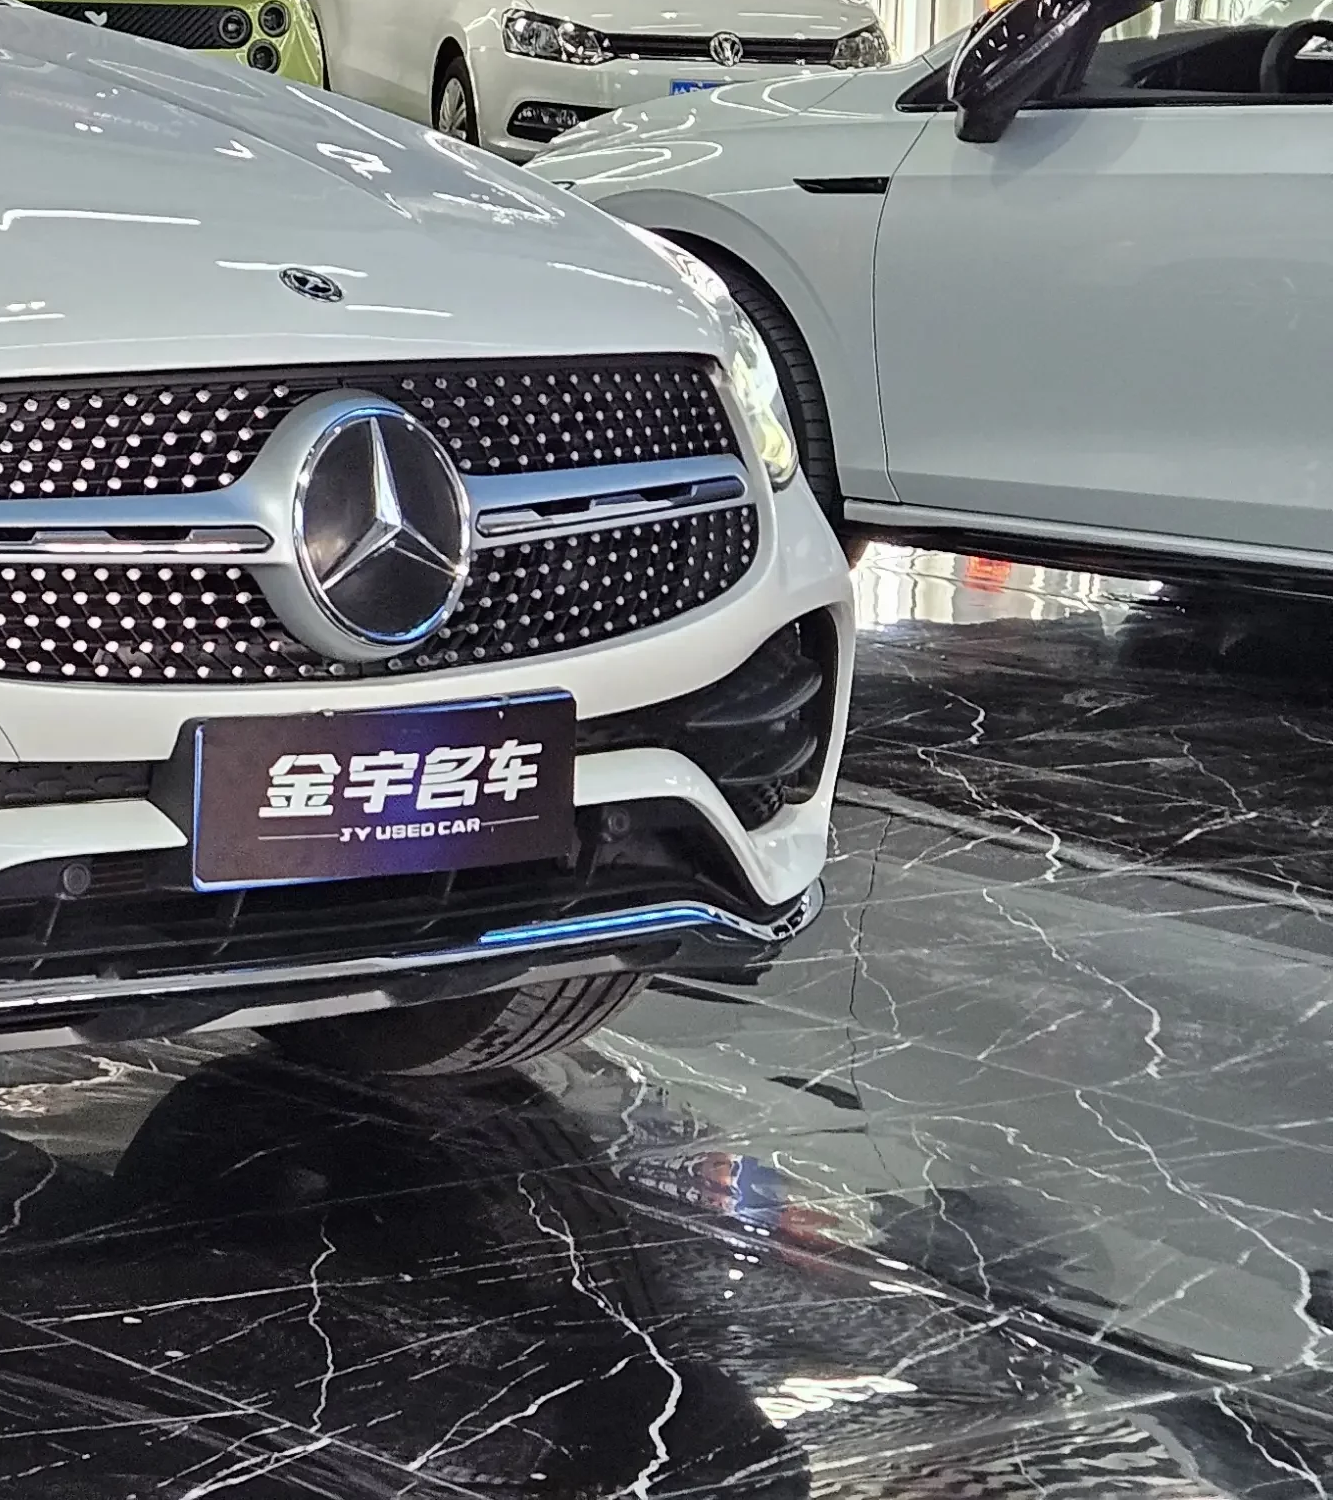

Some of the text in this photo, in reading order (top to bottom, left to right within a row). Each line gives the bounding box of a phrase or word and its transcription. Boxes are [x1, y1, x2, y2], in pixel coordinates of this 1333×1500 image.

[258, 739, 543, 819] 金宇名车
[338, 817, 481, 843] JY USED CAR
